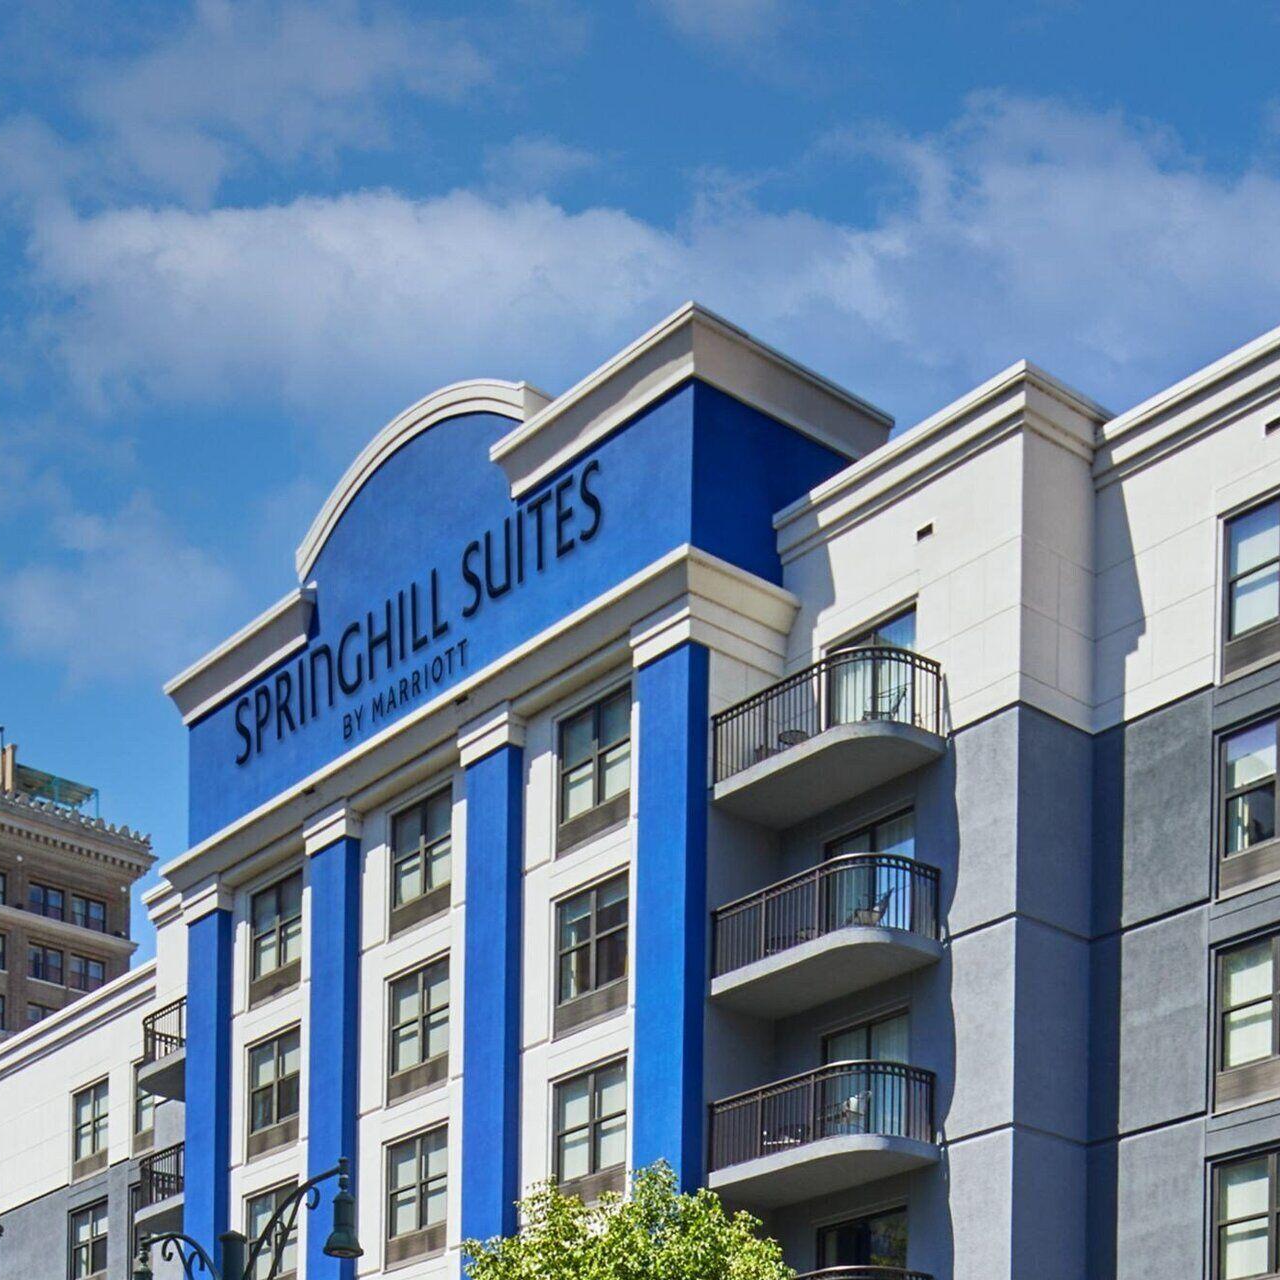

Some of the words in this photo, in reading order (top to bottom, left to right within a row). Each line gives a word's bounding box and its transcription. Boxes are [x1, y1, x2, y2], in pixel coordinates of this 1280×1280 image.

[234, 567, 450, 767] SPRINGHILL
[460, 459, 602, 620] SUITES
[342, 707, 367, 740] BY
[371, 637, 469, 724] MARRIOTT
